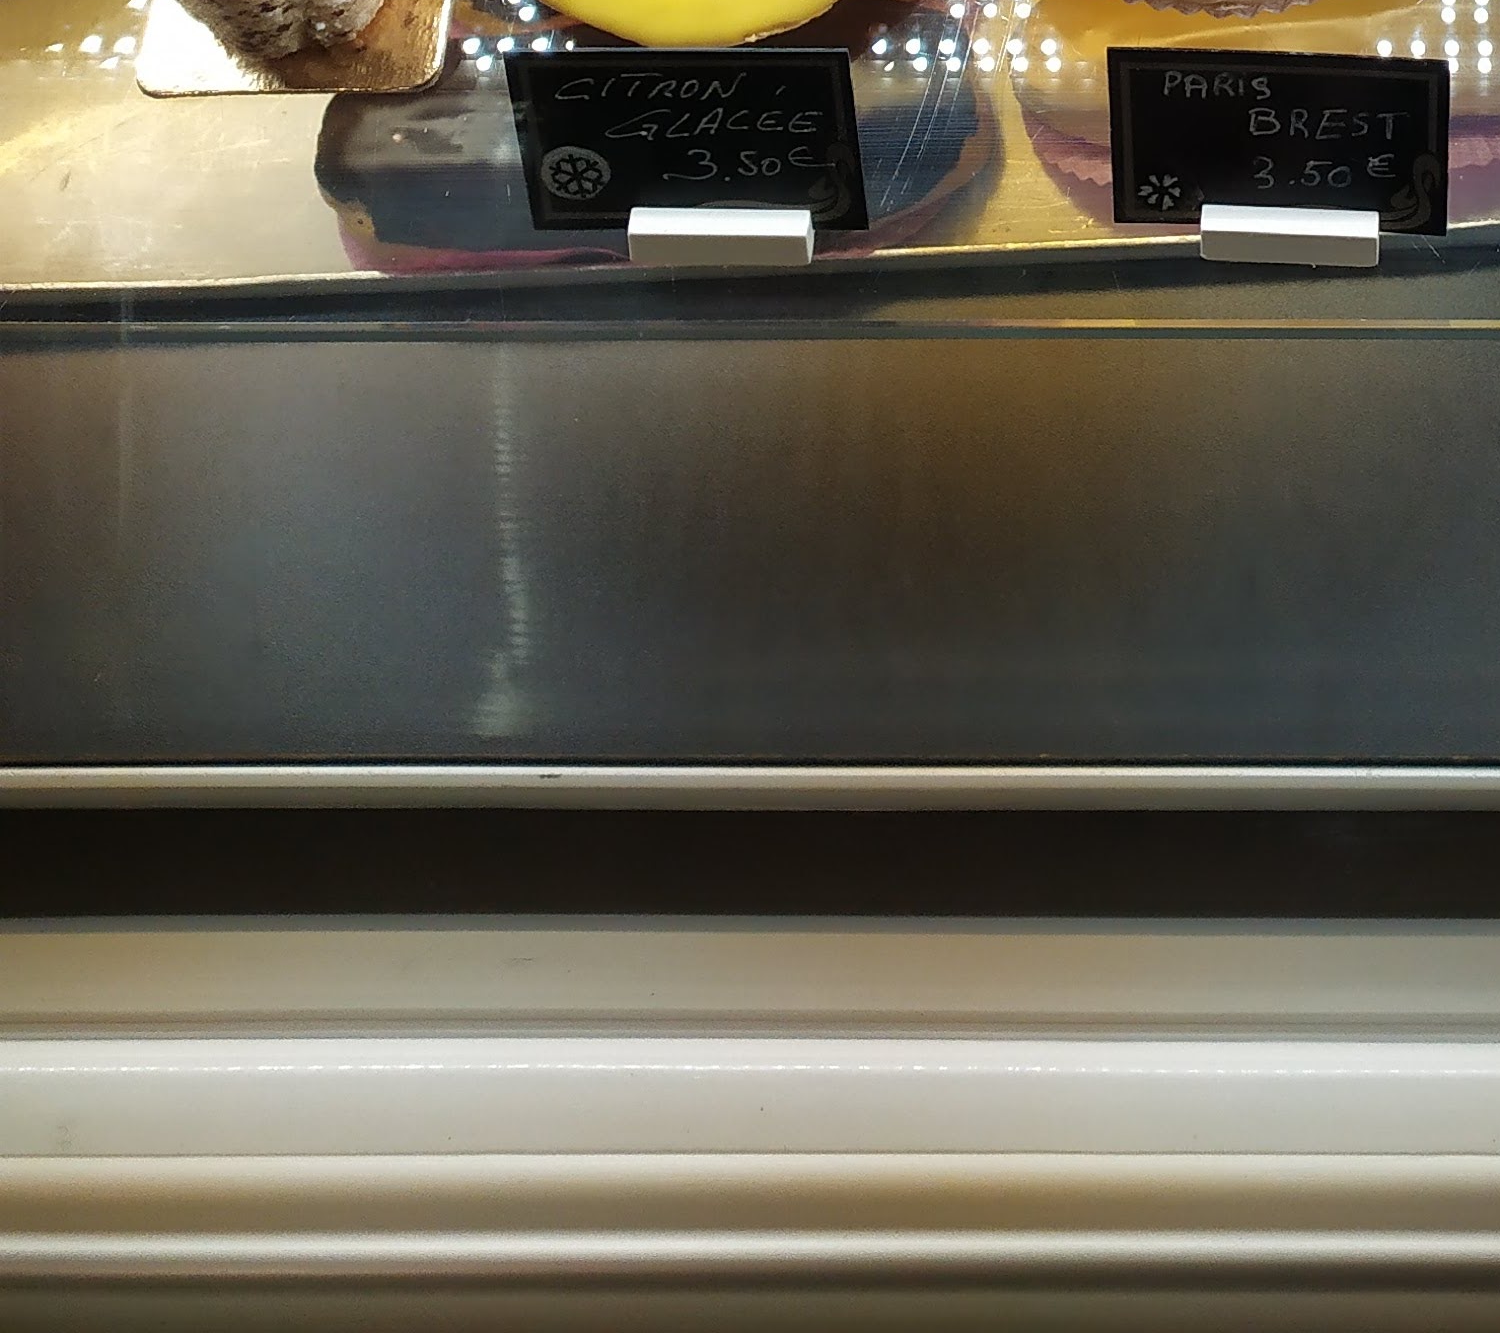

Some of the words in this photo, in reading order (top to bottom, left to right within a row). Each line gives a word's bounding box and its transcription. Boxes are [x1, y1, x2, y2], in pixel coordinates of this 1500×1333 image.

[555, 72, 747, 100] CITRON
[1162, 70, 1271, 100] PARIS
[1249, 108, 1409, 140] BREST
